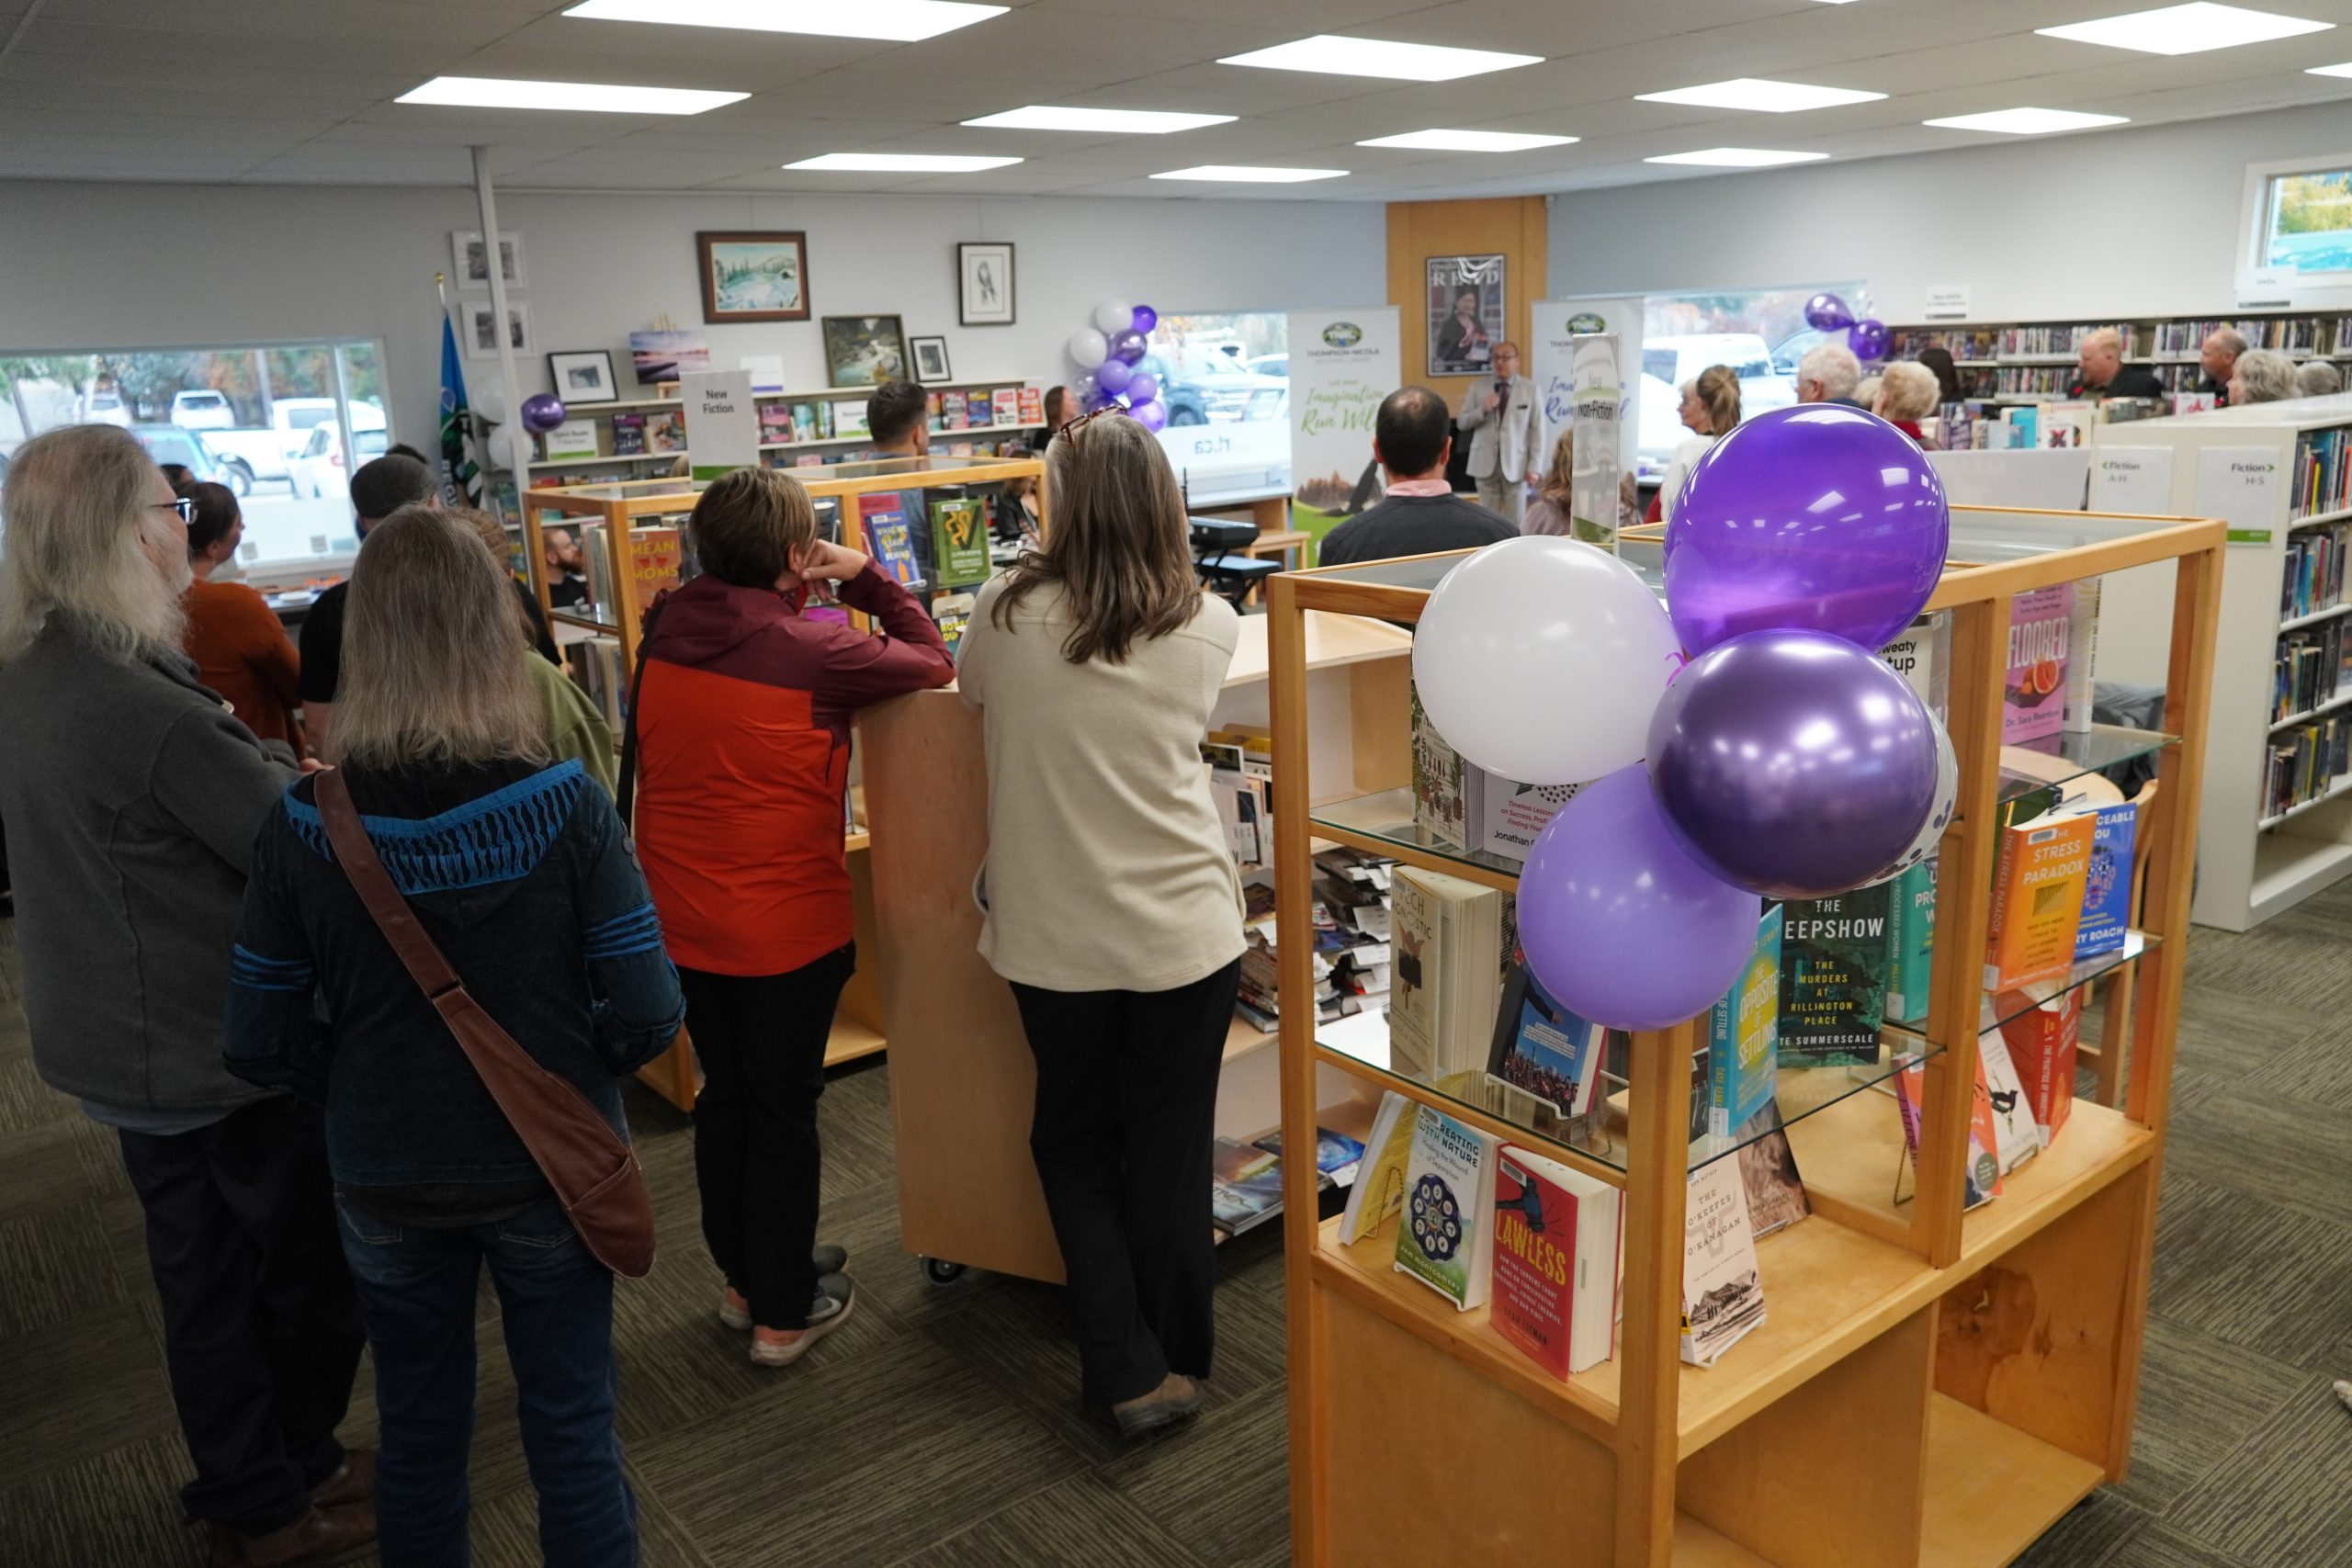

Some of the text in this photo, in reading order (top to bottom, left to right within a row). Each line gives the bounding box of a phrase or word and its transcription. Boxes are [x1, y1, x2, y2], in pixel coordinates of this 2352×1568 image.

[1433, 270, 1499, 287] RED
[706, 389, 728, 400] New
[703, 403, 734, 413] Fiction
[1578, 400, 1613, 421] Non-Fiction
[1301, 404, 1378, 435] Run Wil
[2109, 461, 2140, 470] Fiction
[2231, 463, 2265, 472] Fiction
[631, 542, 675, 555] MEAN
[632, 565, 678, 581] MOMS
[1880, 641, 1917, 654] weaty
[2007, 617, 2068, 670] FLOORED
[2007, 718, 2016, 728] Dr.
[2018, 715, 2031, 726] Sara
[1509, 801, 1555, 816] Timeless Lesson
[1509, 809, 1532, 821] Success,
[1533, 816, 1549, 824] Profi
[1507, 818, 1542, 832] Finding Your
[2097, 810, 2134, 826] CEABLE
[1494, 830, 1529, 847] Jonathan
[2056, 829, 2068, 838] HE
[2094, 829, 2109, 840] OU
[2033, 840, 2081, 863] STRESS
[2023, 859, 2086, 886] PARADOX
[1815, 900, 1841, 913] THE
[1893, 876, 1901, 928] A-PROCESSED
[1992, 890, 2006, 933] PARADOX
[1391, 901, 1431, 940] AGNOSTIC
[1785, 918, 1883, 940] EEPSHOW
[2076, 926, 2124, 943] RY ROACH
[1799, 974, 1848, 983] MURDERS
[1740, 969, 1779, 1023] OPPOSITE
[1816, 988, 1829, 997] AT
[1791, 1001, 1853, 1011] RILLINGTON
[1716, 999, 1727, 1040] OF SETTLING
[1804, 1016, 1837, 1025] PLACE
[1738, 1017, 1777, 1070] SETTLING
[1780, 1034, 1873, 1046] TE SUMMERSCALE
[1418, 1120, 1478, 1168] WITH NATURE
[1430, 1118, 1479, 1156] REATING
[1422, 1138, 1440, 1158] Healing
[1449, 1154, 1468, 1175] Wound
[1426, 1155, 1459, 1182] of Separation
[1699, 1189, 1716, 1205] THE
[1688, 1194, 1732, 1226] O'KEEFES
[1707, 1216, 1717, 1229] OF
[1688, 1217, 1741, 1257] O'KANAGAN
[1495, 1209, 1566, 1286] LAWLESS
[1400, 1246, 1413, 1259] PAM
[1415, 1256, 1460, 1292] MONTGOMERY
[1499, 1254, 1558, 1300] HOW THE SUPREME COURT
[1501, 1265, 1555, 1309] RUNS ON CONSERVATIVE
[1509, 1293, 1544, 1324] AND BAD VIBES
